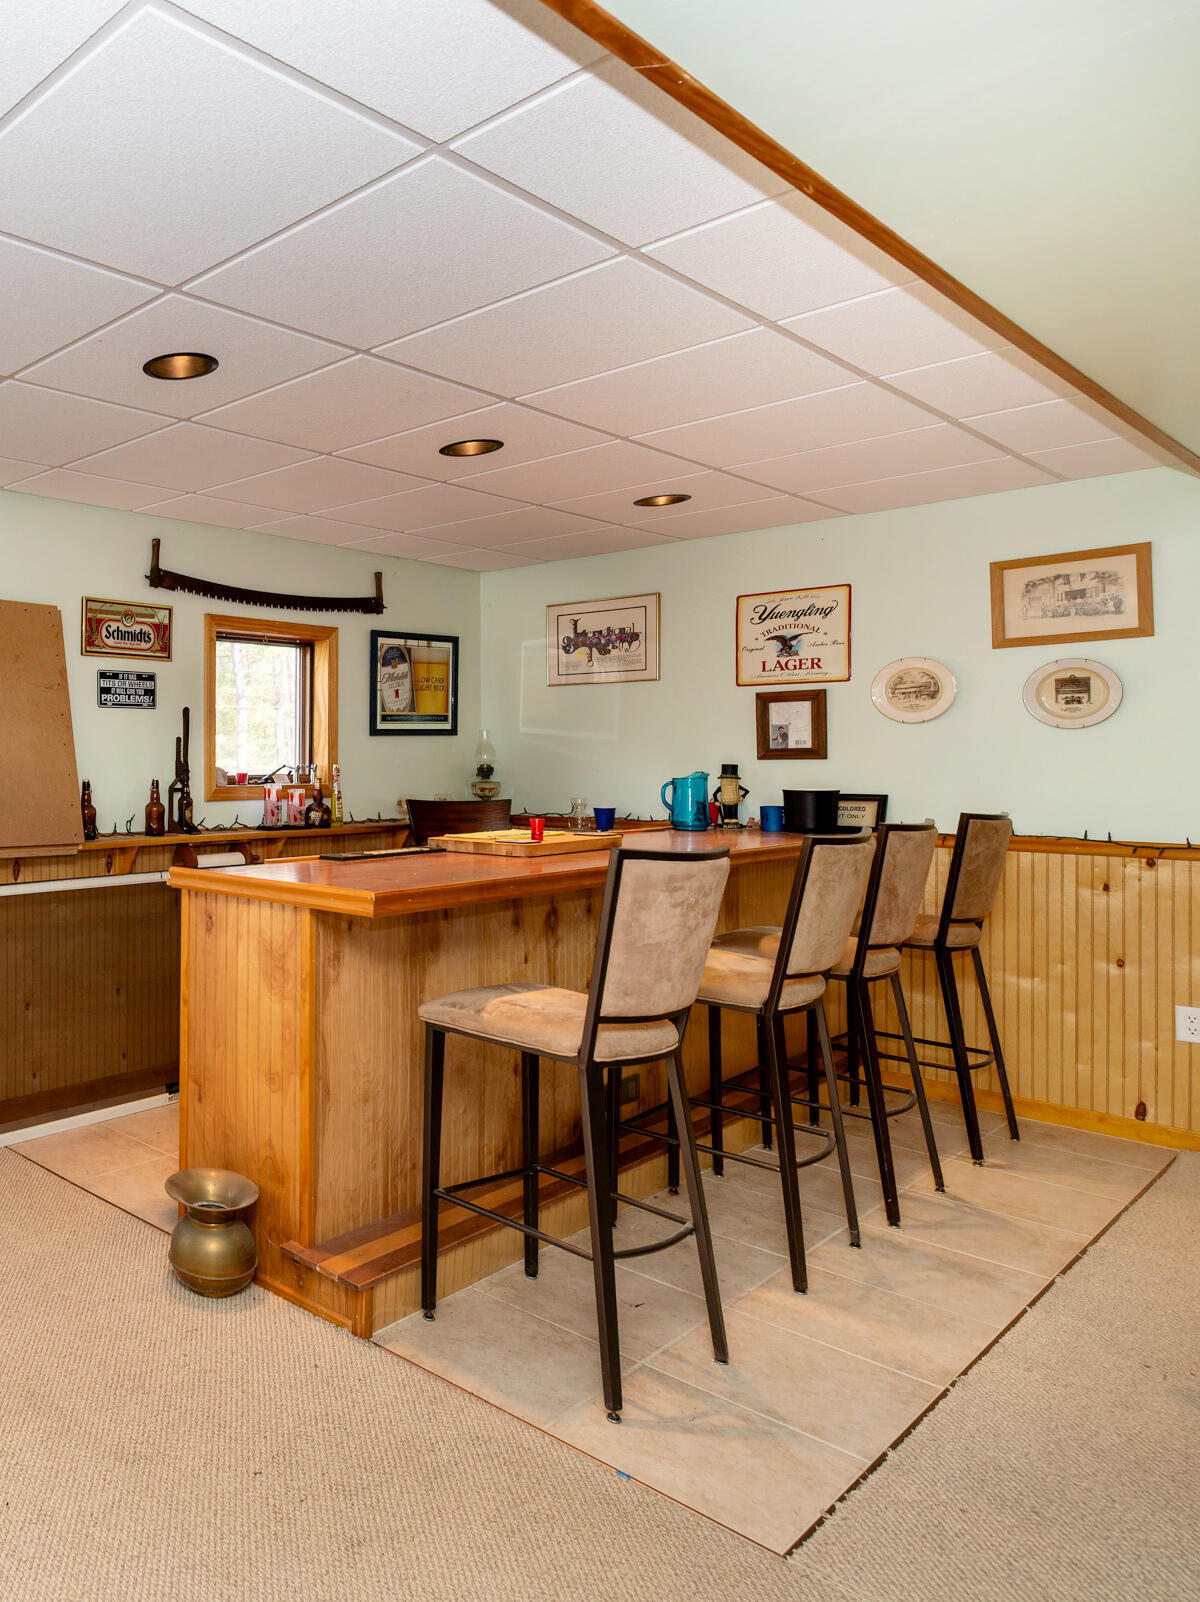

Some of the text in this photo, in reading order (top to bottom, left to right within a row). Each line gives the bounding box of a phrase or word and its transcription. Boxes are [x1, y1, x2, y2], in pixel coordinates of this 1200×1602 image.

[750, 600, 839, 625] Yuengling
[105, 624, 152, 644] Schmidt's
[760, 623, 820, 637] TRADITIONAL
[761, 657, 822, 672] LAGER
[101, 694, 153, 703] PROBLEMS!
